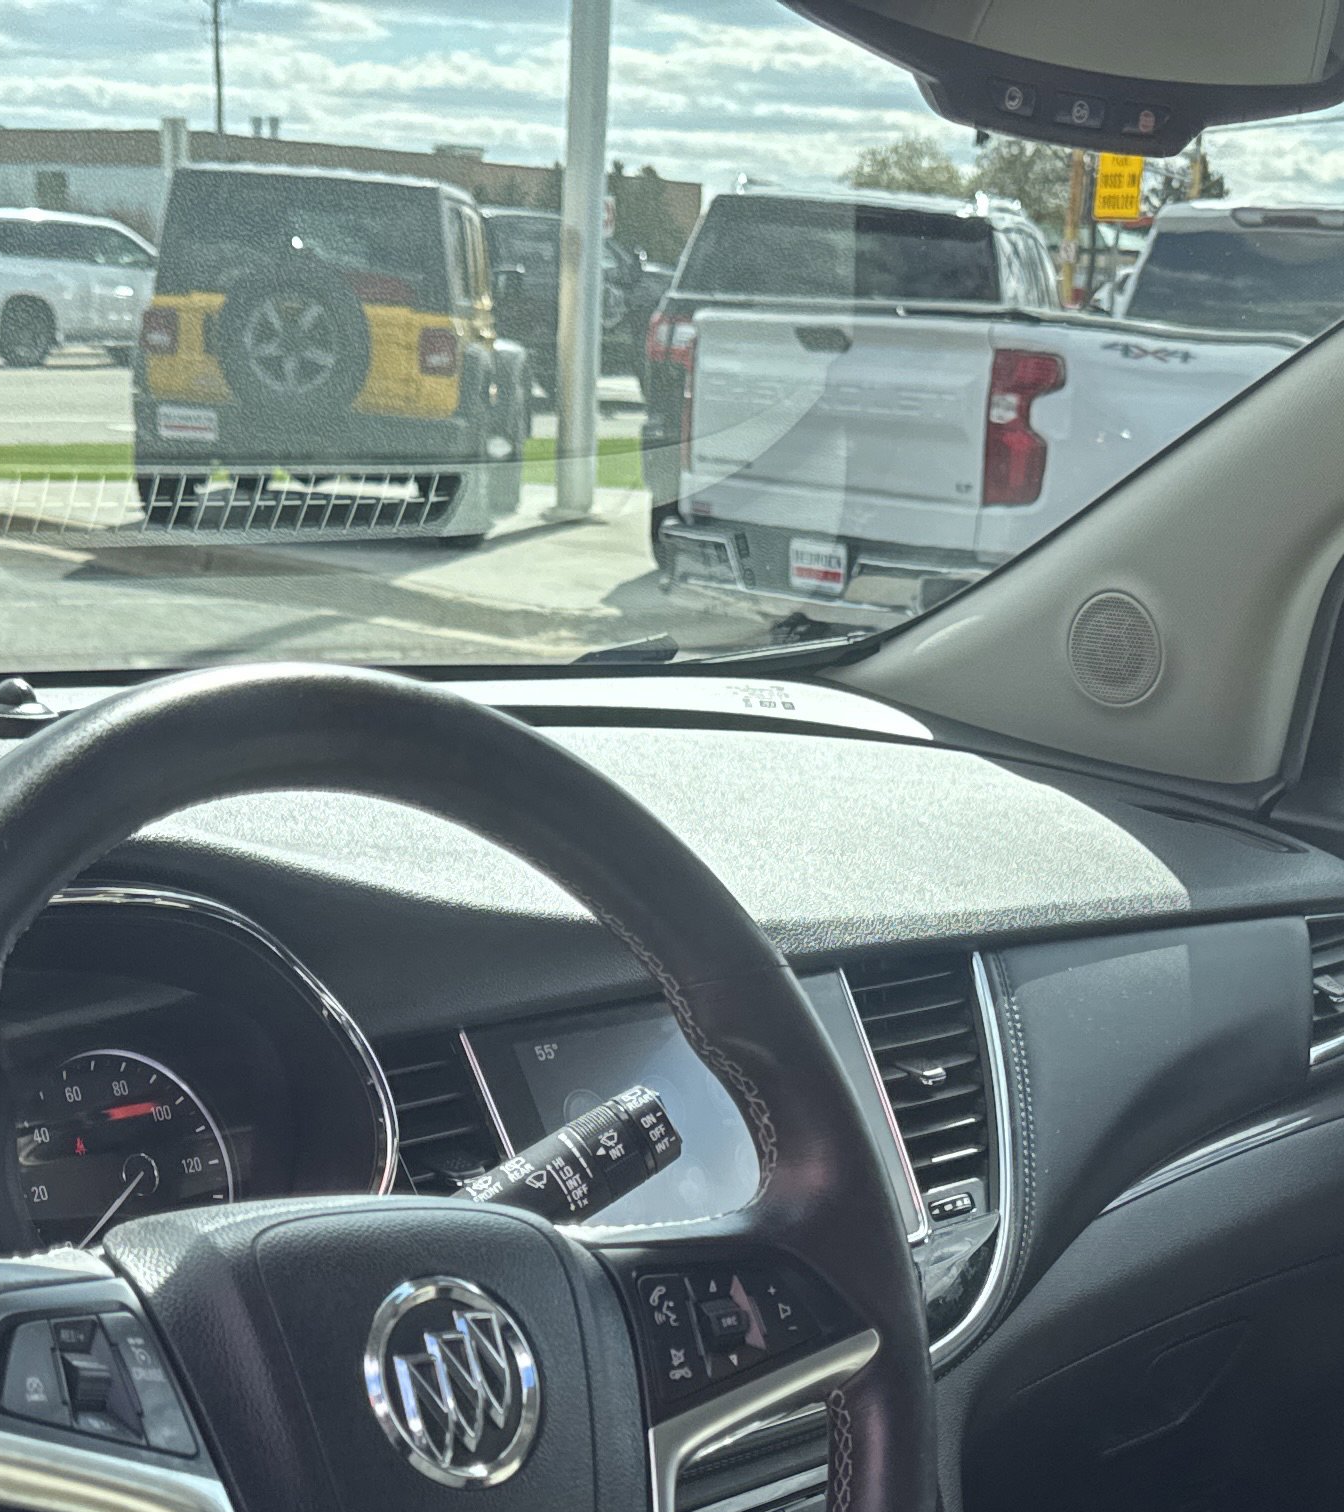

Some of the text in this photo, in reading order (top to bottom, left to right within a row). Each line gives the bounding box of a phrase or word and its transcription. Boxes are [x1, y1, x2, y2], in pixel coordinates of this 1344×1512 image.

[64, 1086, 82, 1103] 60
[112, 1080, 129, 1096] 80
[627, 1090, 655, 1111] REAR
[151, 1105, 172, 1121] 100
[640, 1113, 657, 1129] ON
[33, 1127, 50, 1143] 40
[649, 1125, 666, 1142] OFF
[608, 1143, 625, 1160] INT
[655, 1137, 671, 1154] INT
[181, 1157, 202, 1173] 120
[552, 1155, 565, 1169] HI
[507, 1163, 535, 1183] REAR
[559, 1166, 574, 1181] LO
[566, 1175, 582, 1191] INT
[31, 1185, 49, 1202] 20
[473, 1181, 504, 1203] FRONT
[571, 1184, 590, 1201] OFF
